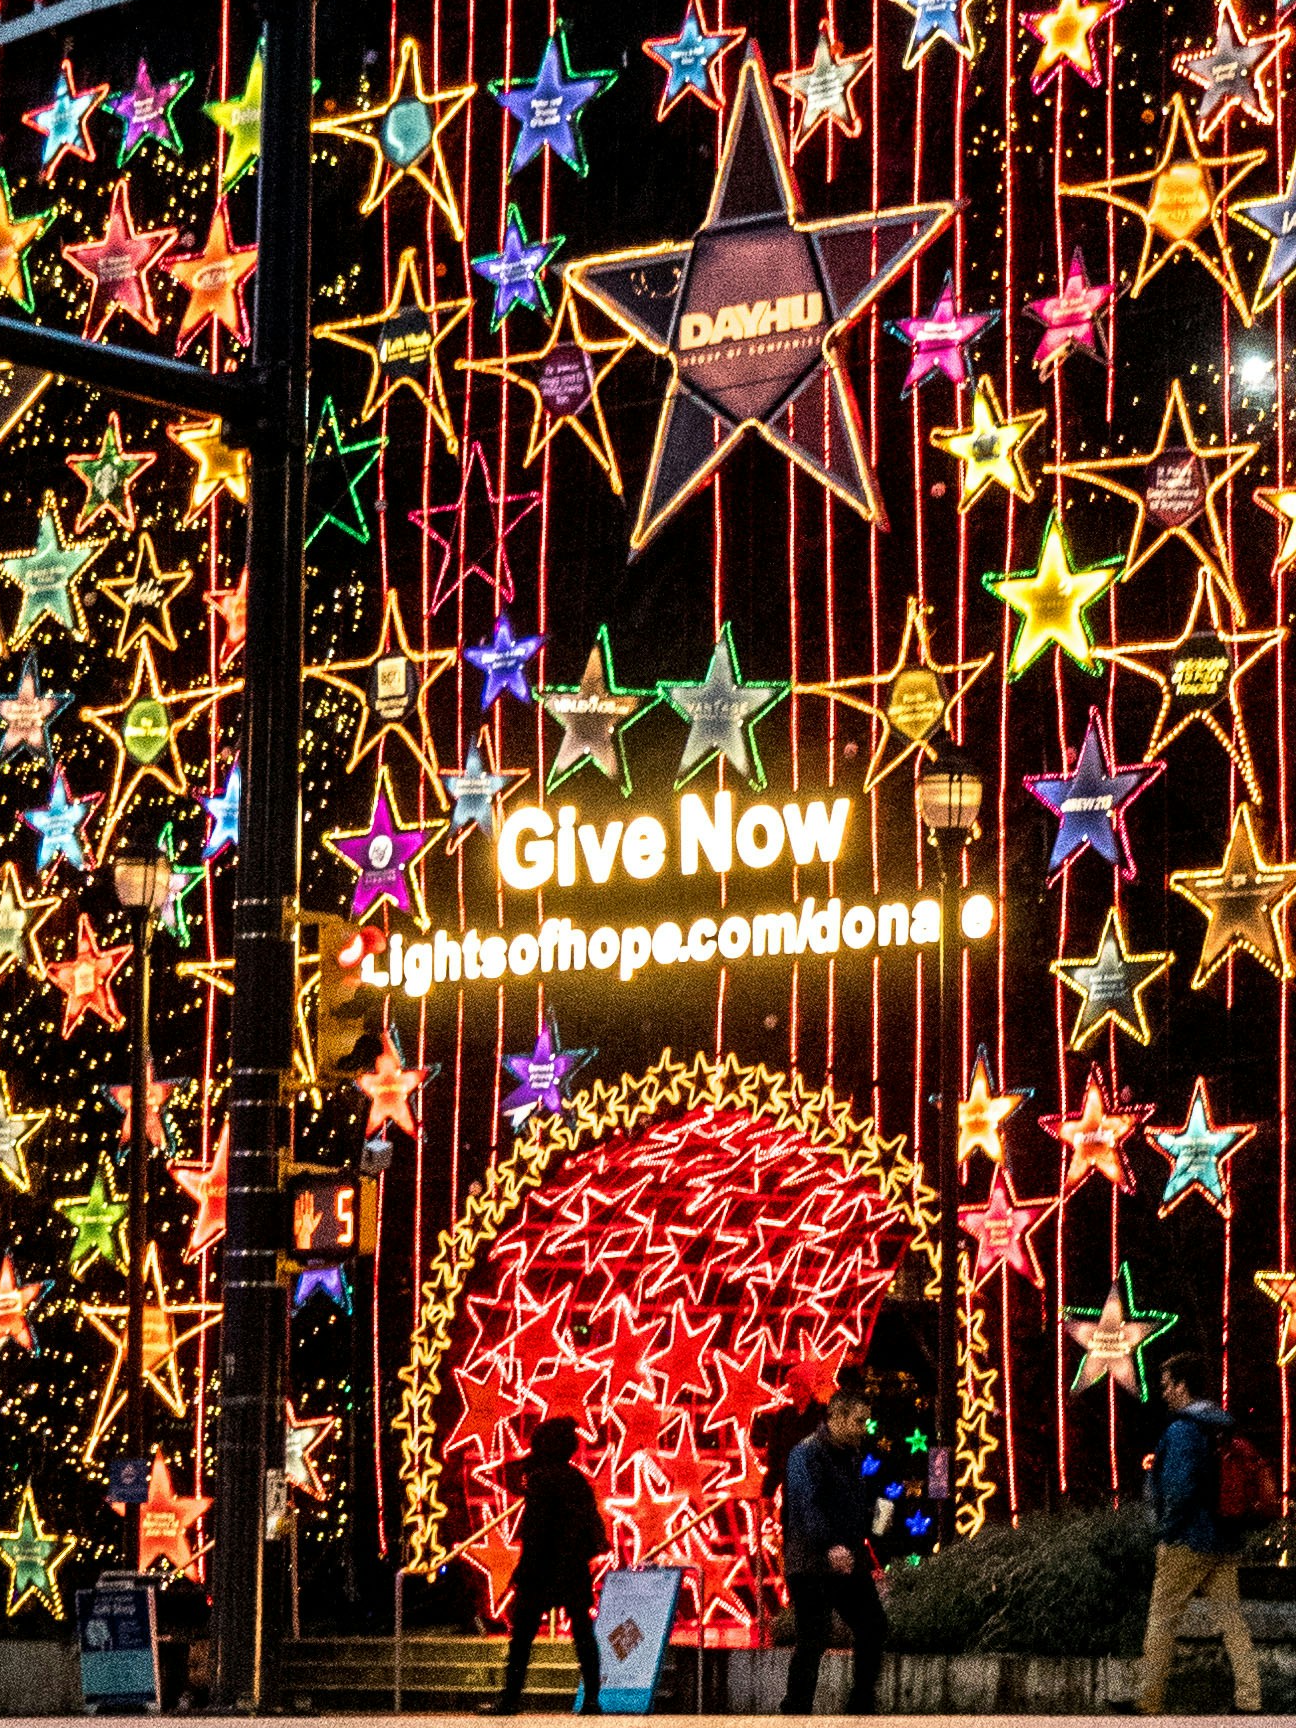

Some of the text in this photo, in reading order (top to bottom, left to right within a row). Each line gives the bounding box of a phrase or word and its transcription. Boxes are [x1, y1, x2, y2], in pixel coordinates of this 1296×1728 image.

[680, 292, 823, 351] DAYHU
[496, 791, 851, 891] Give Now
[360, 893, 995, 997] Lightsofhope.com/donae
[336, 1187, 354, 1245] 5
